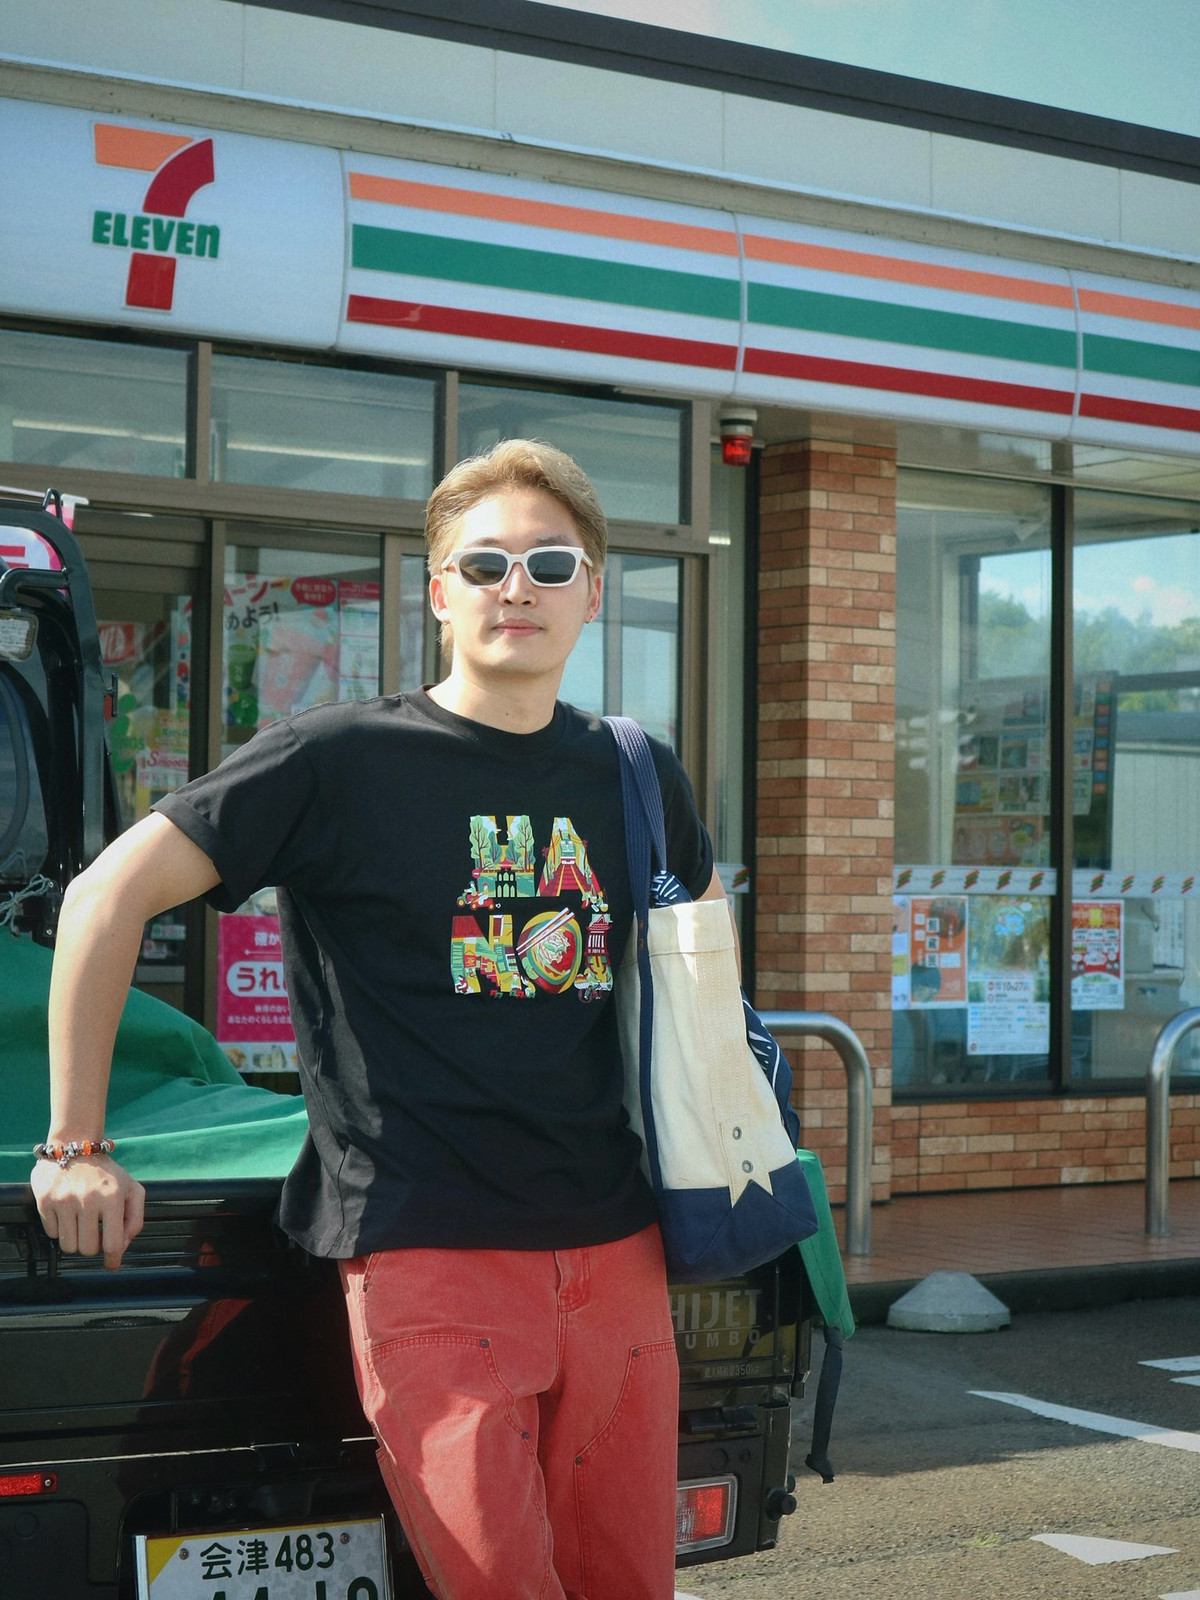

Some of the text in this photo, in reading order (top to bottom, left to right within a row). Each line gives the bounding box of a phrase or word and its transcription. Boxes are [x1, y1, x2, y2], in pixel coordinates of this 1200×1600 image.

[94, 123, 214, 310] 7
[466, 814, 604, 900] HA
[236, 966, 288, 992] うれ
[450, 909, 613, 996] NOI
[669, 1289, 762, 1331] HIJET
[200, 1532, 335, 1580] 会津 483
